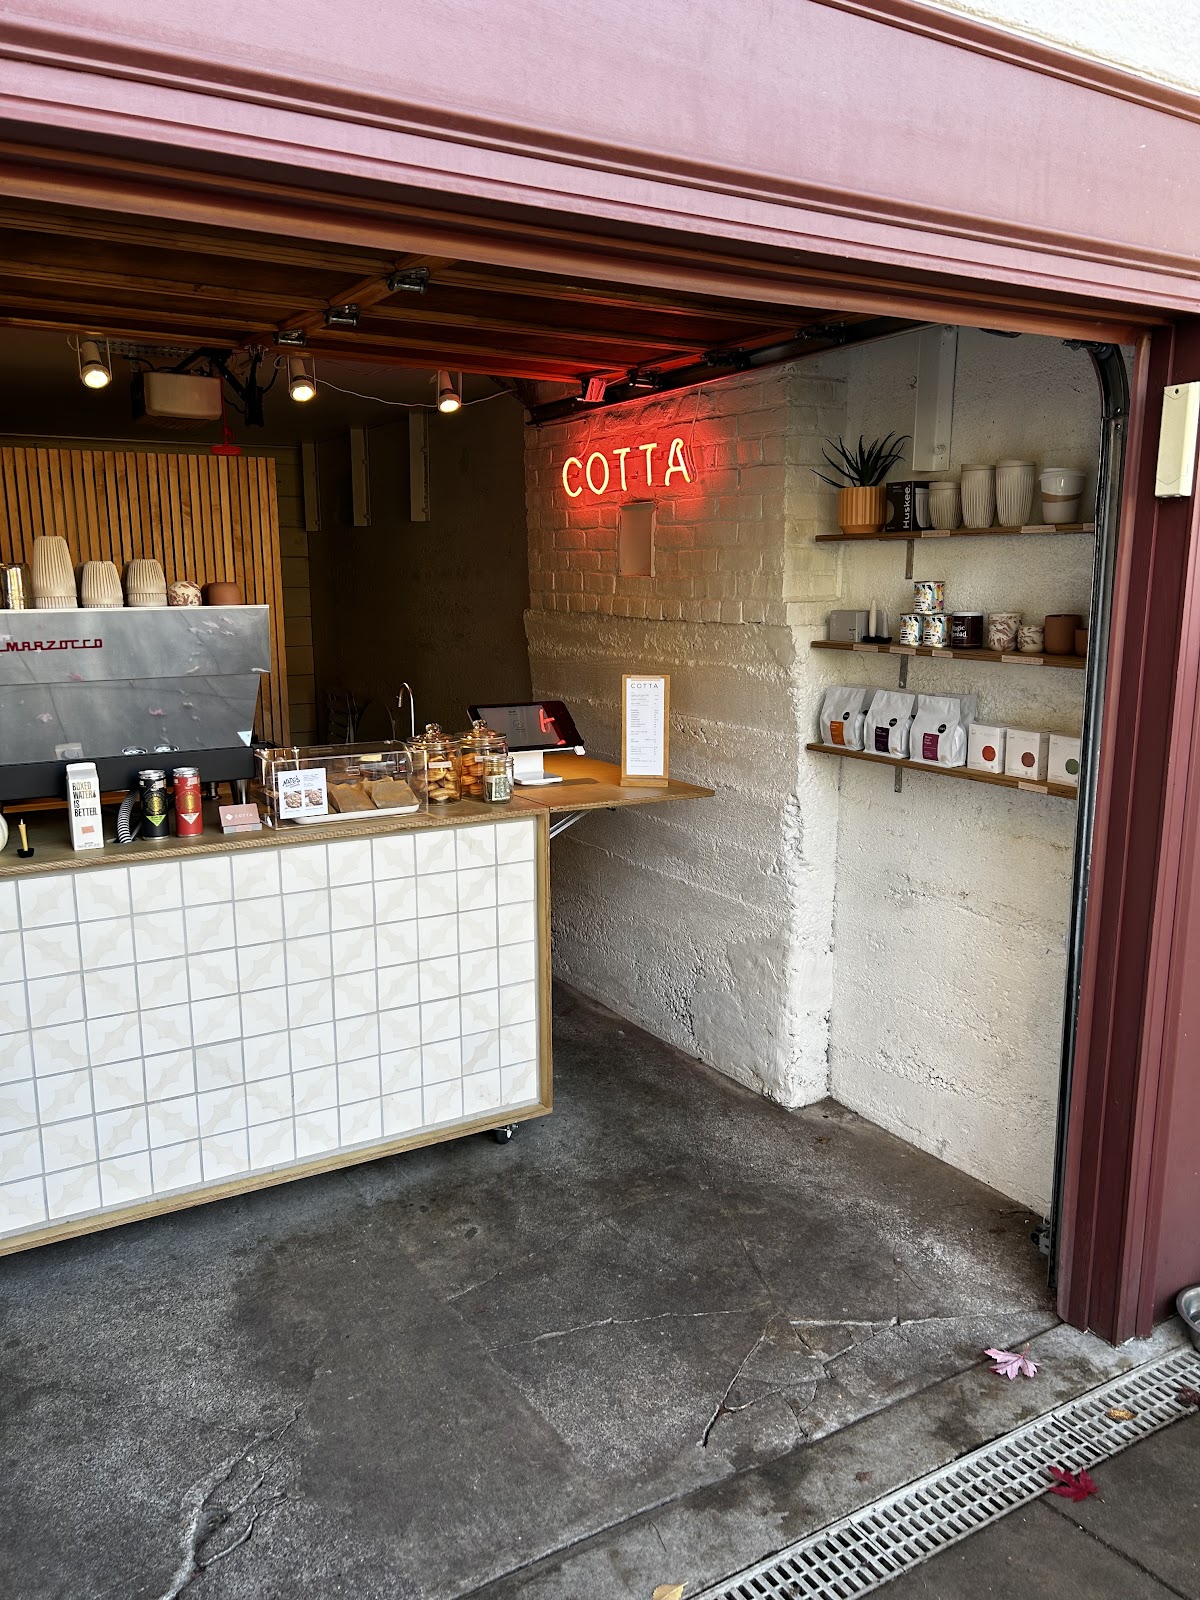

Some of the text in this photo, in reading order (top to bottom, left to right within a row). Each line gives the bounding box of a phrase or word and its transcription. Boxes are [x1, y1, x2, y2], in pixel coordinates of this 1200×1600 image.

[562, 438, 691, 497] COTTA
[902, 484, 911, 529] Huskee.
[72, 781, 91, 791] BOXED
[74, 800, 80, 808] IS
